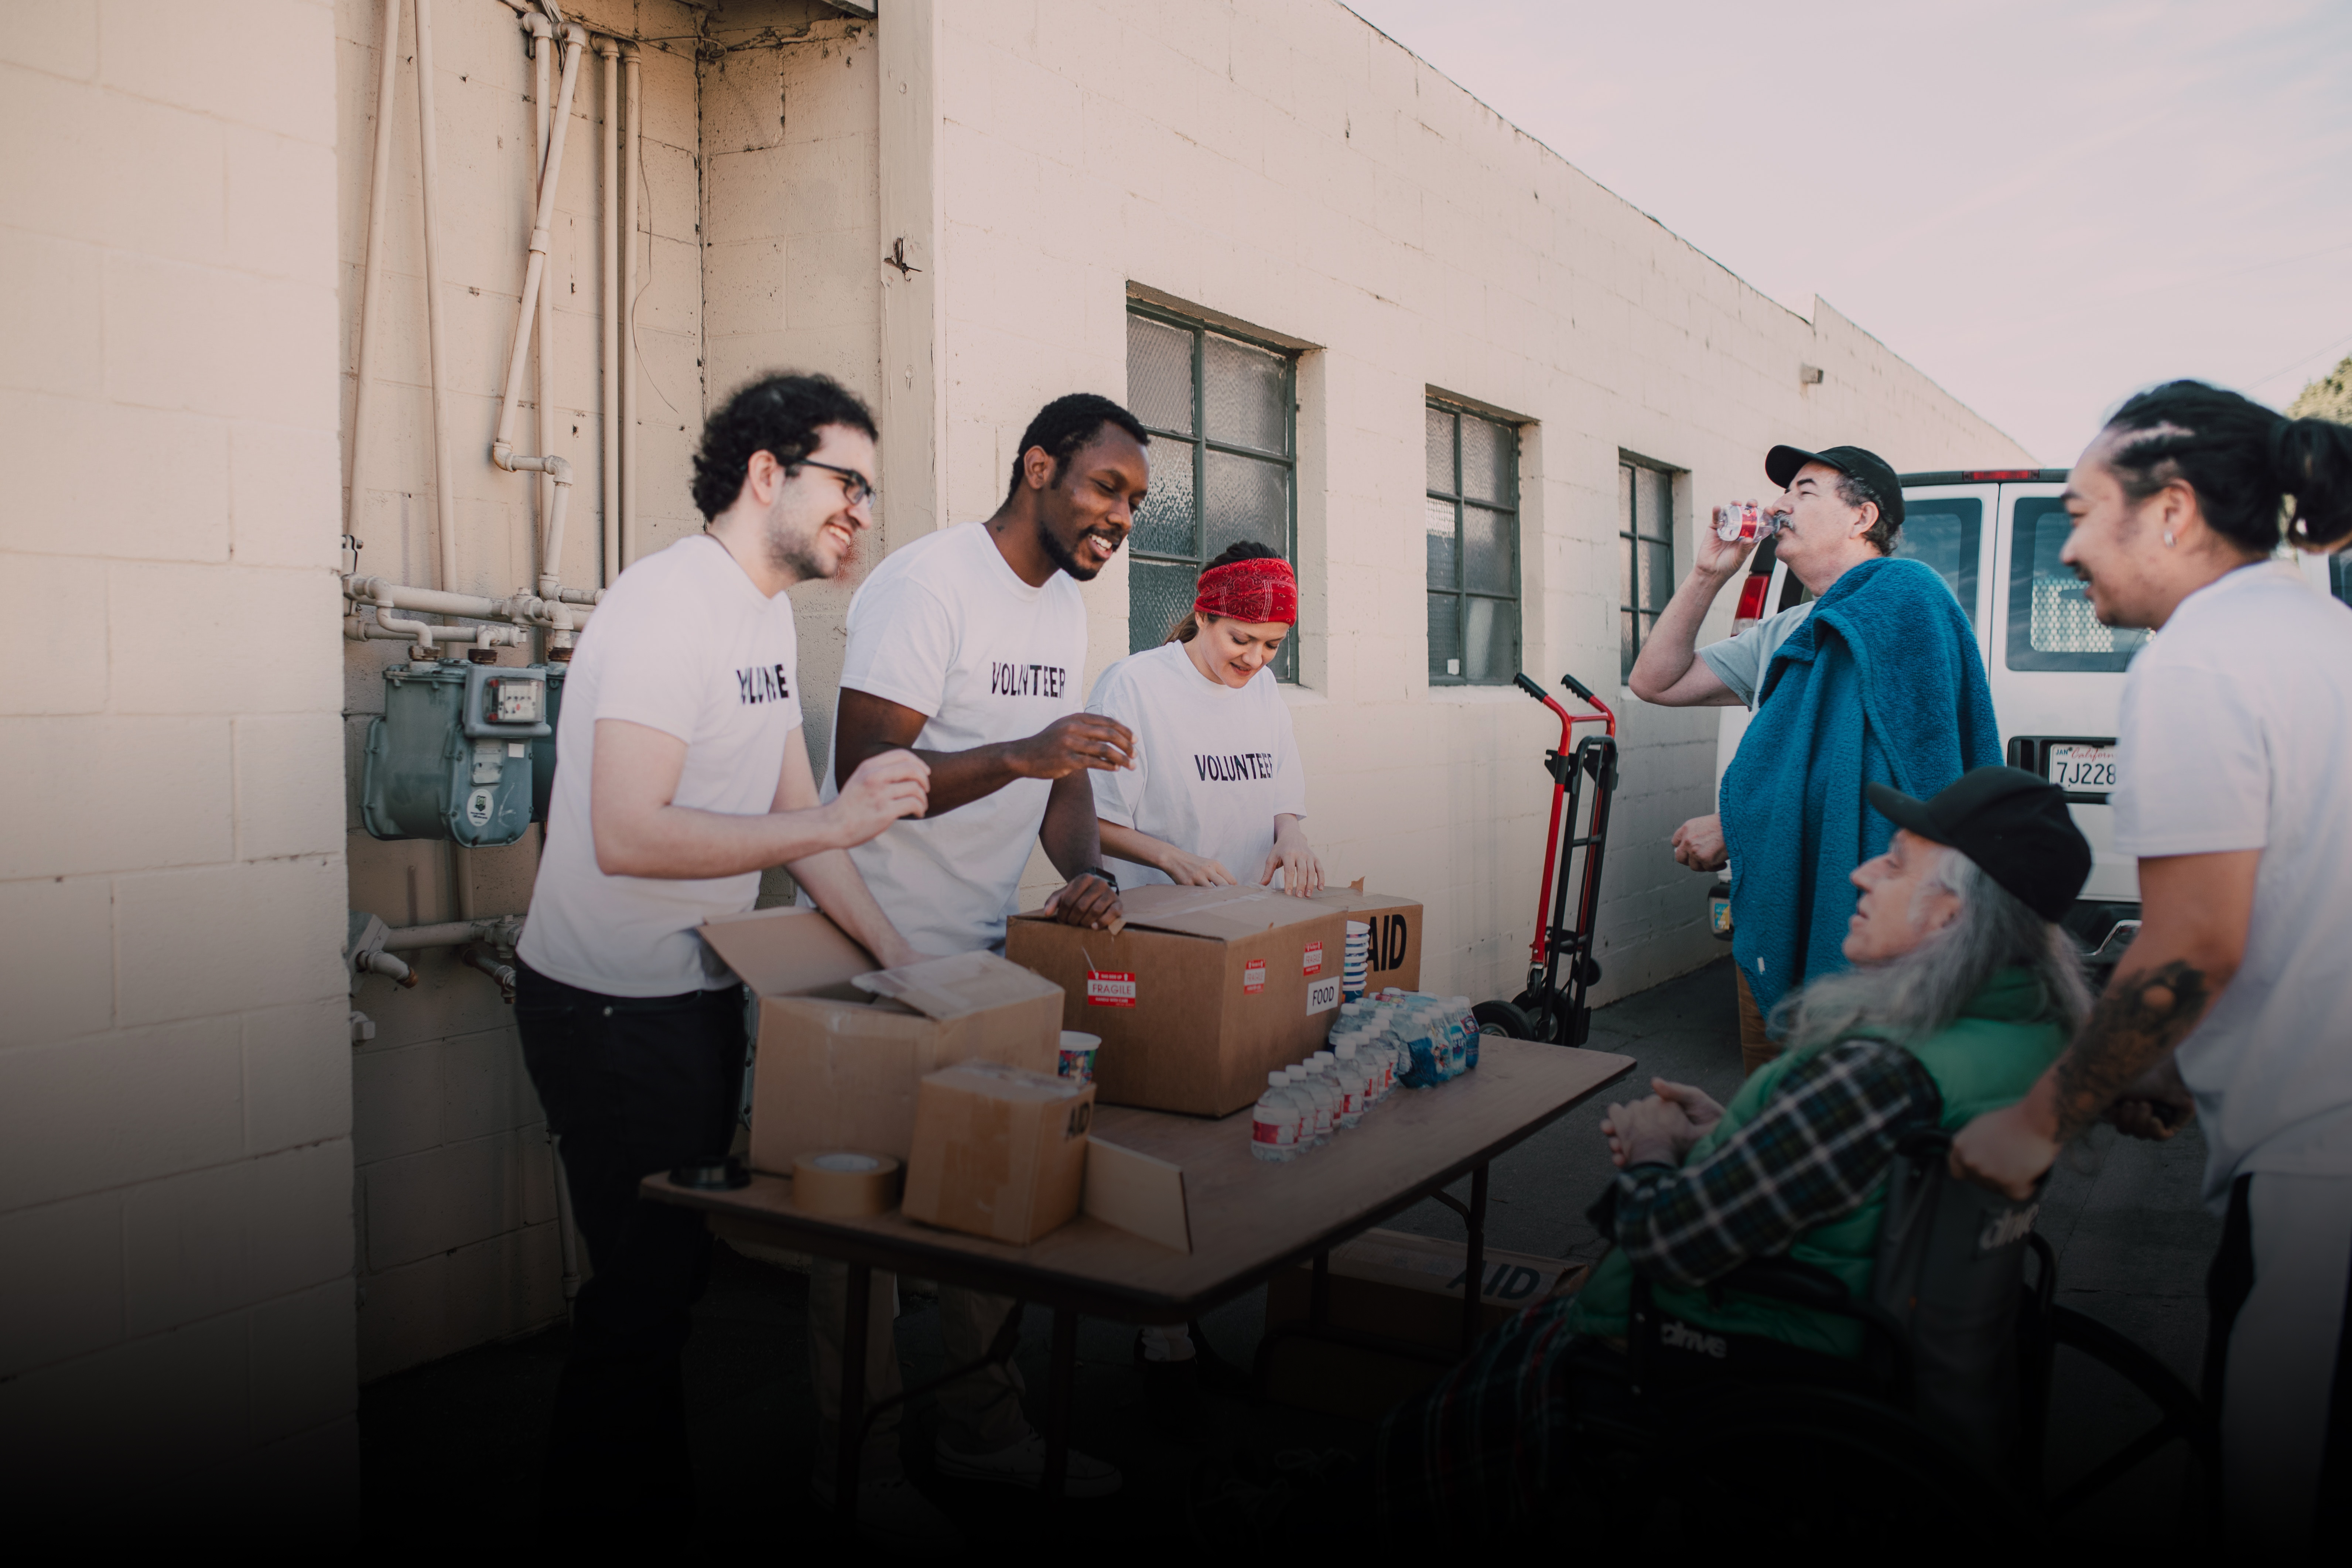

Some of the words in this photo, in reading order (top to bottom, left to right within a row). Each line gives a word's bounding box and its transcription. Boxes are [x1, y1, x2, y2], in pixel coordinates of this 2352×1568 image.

[2071, 747, 2114, 762] Californ
[2057, 762, 2116, 785] 7J228
[1366, 914, 1406, 971] AID
[1093, 984, 1131, 995] FRAGILE
[1312, 986, 1334, 1006] FOOD
